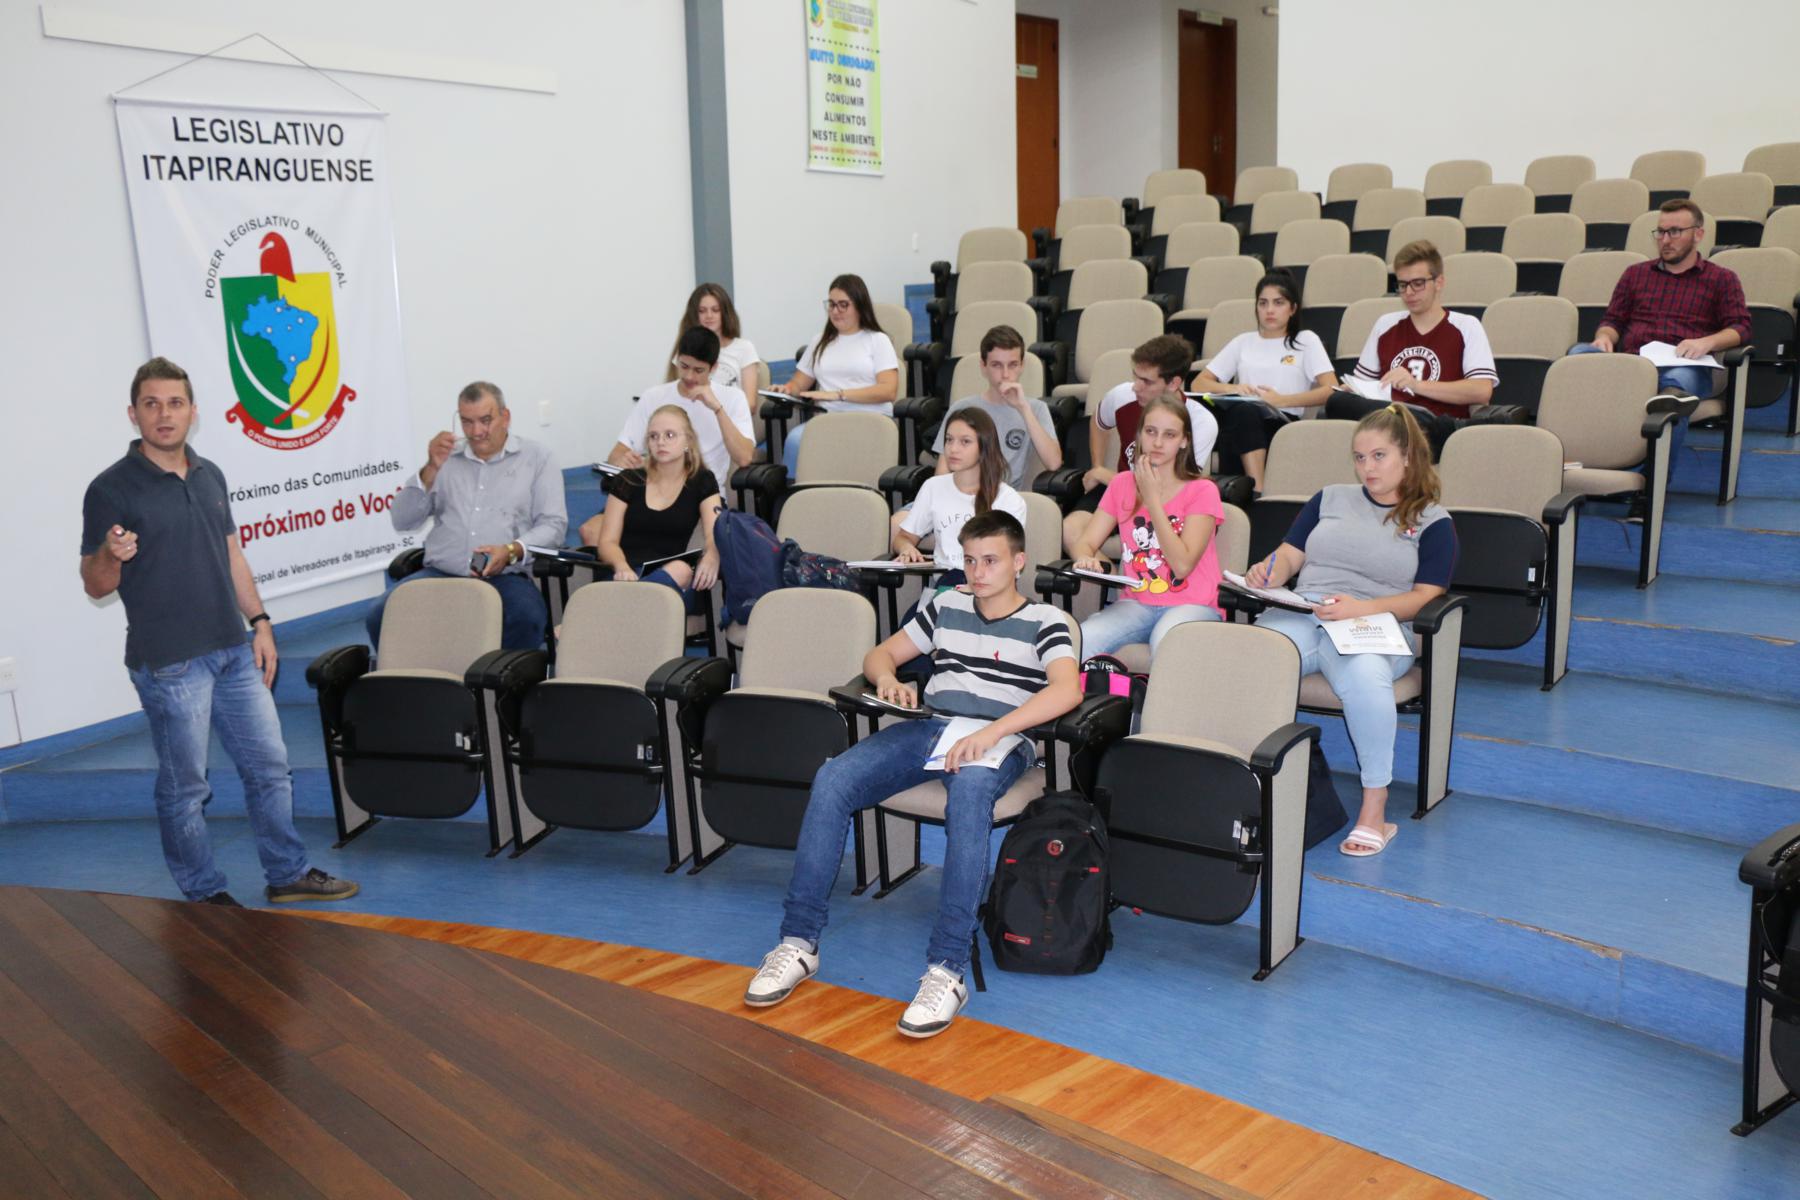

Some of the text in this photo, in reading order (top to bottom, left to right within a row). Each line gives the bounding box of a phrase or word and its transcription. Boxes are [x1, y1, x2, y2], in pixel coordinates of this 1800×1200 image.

[824, 92, 865, 107] CONSUMIR
[172, 116, 344, 147] LEGISLATIVO
[823, 111, 867, 127] ALIMENTOS
[812, 129, 876, 146] NESTE AMBIENTE
[143, 154, 374, 182] ITAPIRANGUENSE
[204, 215, 348, 298] PODER LEGISLATIVO MUNICIPAL
[230, 459, 404, 503] róximo das Comunidades.
[240, 486, 404, 549] próximo de Voc
[252, 569, 276, 585] cipal
[277, 563, 289, 578] de
[290, 554, 340, 575] Vereadores
[342, 549, 353, 562] de
[354, 541, 396, 560] Itapiranga
[402, 536, 415, 548] SC
